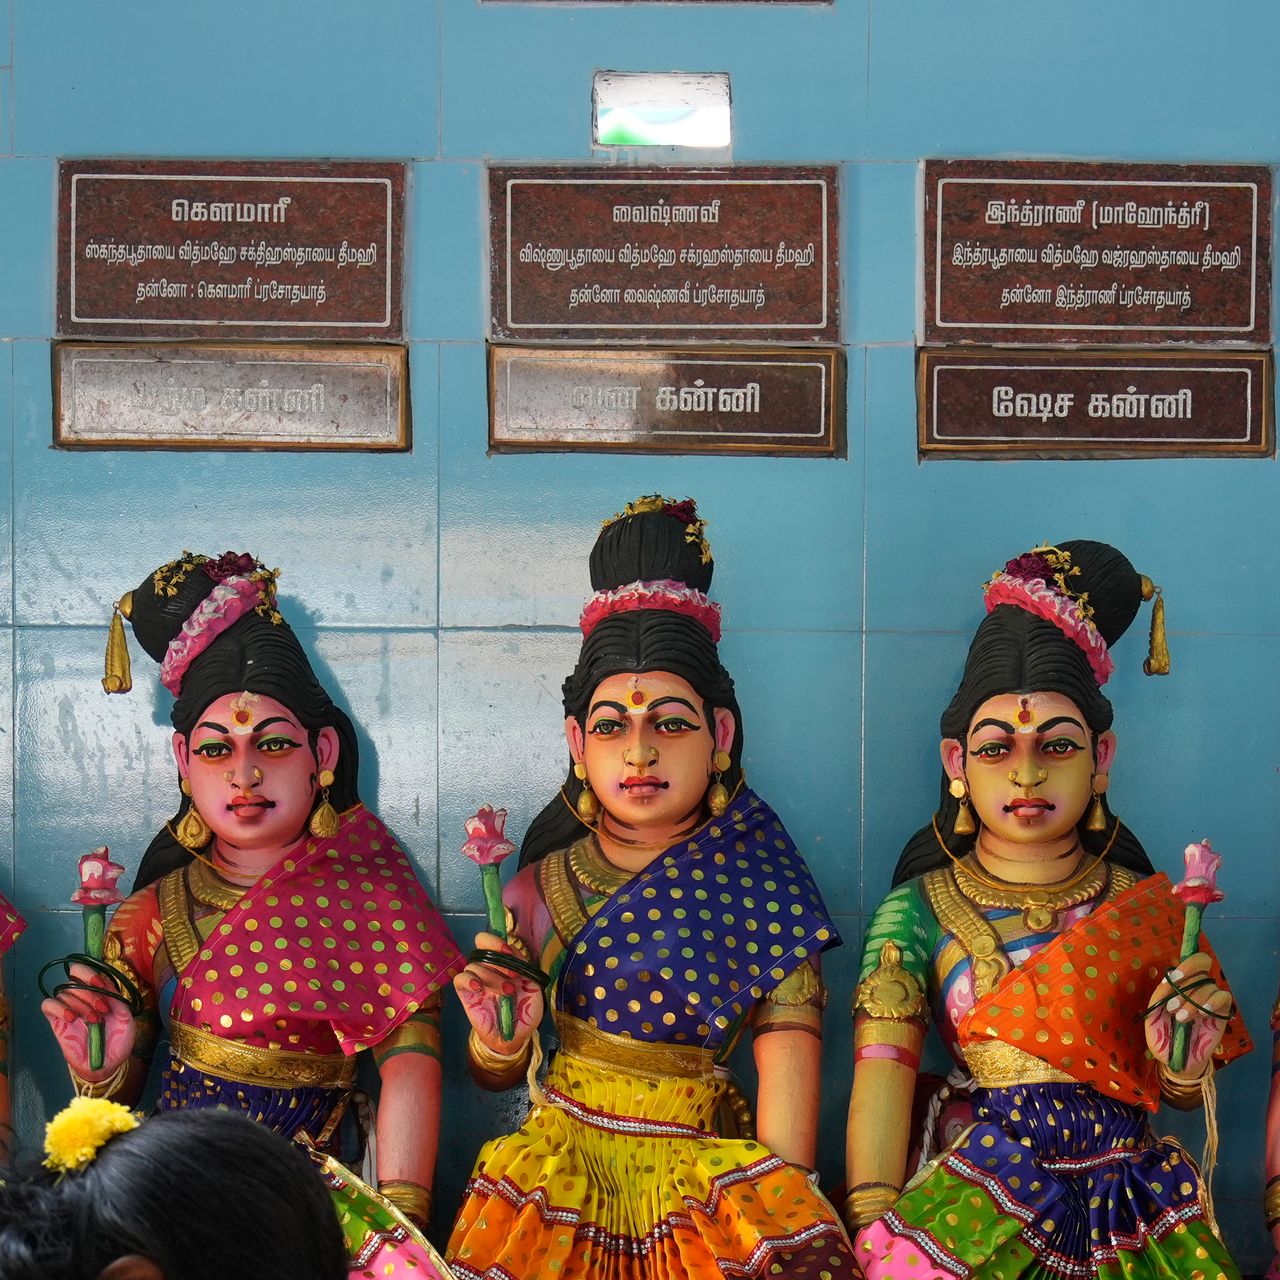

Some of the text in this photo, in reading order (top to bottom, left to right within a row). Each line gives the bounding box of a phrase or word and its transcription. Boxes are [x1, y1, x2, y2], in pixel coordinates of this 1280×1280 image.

[171, 196, 292, 223] கௌமாரீ
[612, 198, 721, 227] வைஷ்ணவீ
[984, 197, 1210, 231] இந்த்ராணீ (மாஹேந்த்ரீ)
[85, 238, 377, 269] ஸ்கந்தபூதாயை வித்மஹே சக்திஹஸ்தாயை தீமஹி
[519, 240, 815, 272] விஷ்ணுபூதாயை வித்மஹே சக்ரஹஸ்தாயை தீமஹி
[951, 241, 1242, 273] இந்த்ரபூதாயை வித்மஹே வஜ்ரஹஸ்தாயை தீமஹி
[135, 277, 188, 305] தன்னோ
[197, 277, 253, 299] கௌமாரீ
[254, 277, 327, 307] ப்ரசோதயாத்
[568, 282, 766, 311] தன்னோ வைஷ்ணவீ ப்ரசோதயாத்
[999, 281, 1192, 312] தன்னோ இந்த்ராணீ ப்ரசோதயாத்
[656, 378, 762, 414] கன்னி
[991, 384, 1193, 424] ஷேச கன்னி
